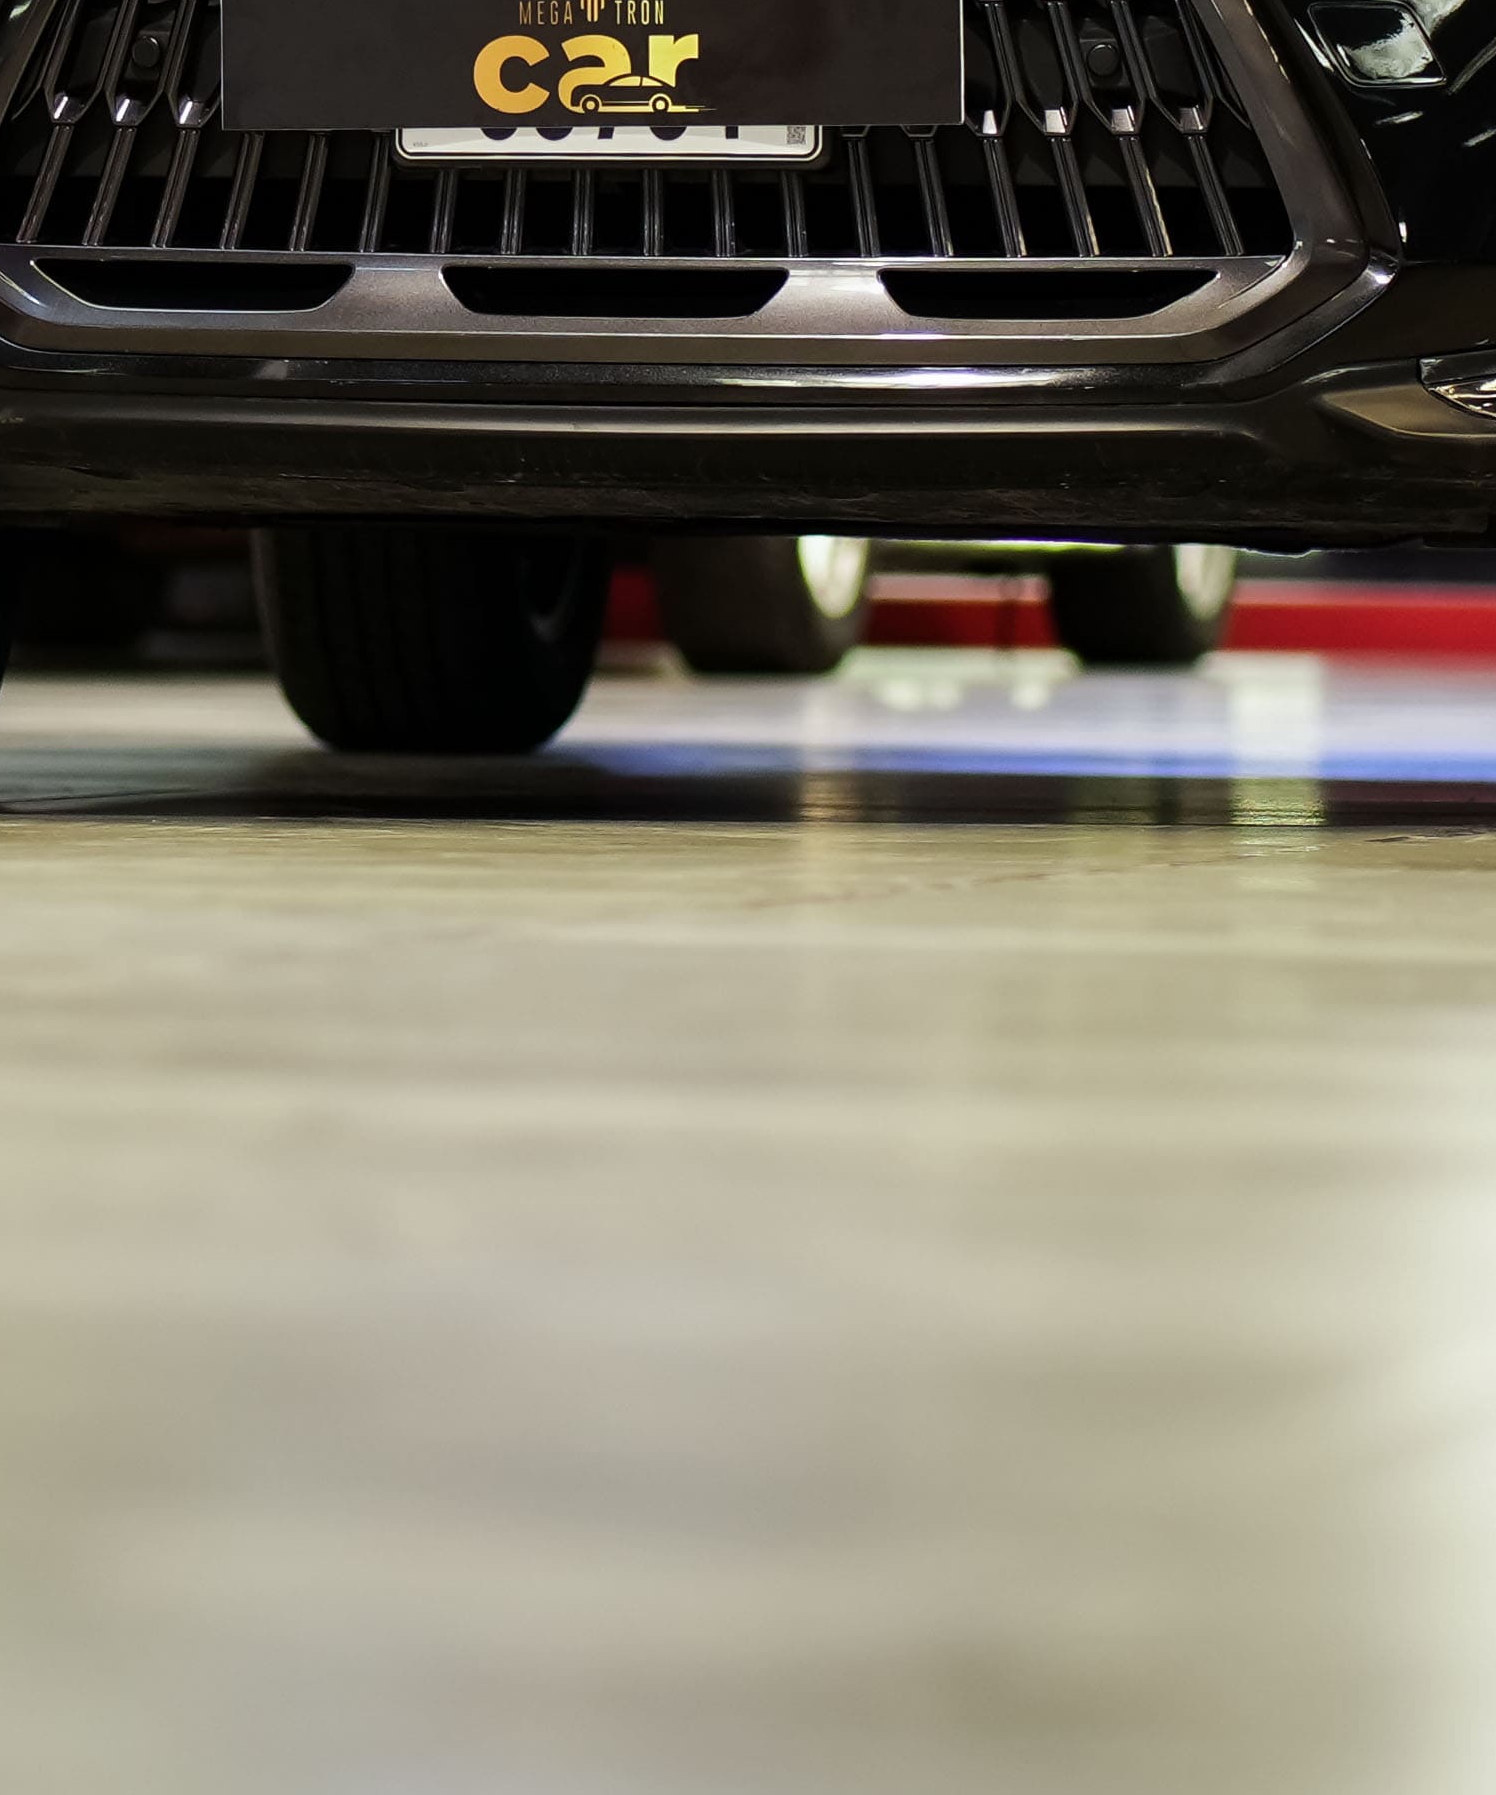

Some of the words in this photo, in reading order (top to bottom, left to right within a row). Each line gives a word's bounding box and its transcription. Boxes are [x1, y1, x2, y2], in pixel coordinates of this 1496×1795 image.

[518, 0, 574, 26] MEGA
[614, 0, 665, 26] TRON
[473, 33, 699, 115] car
